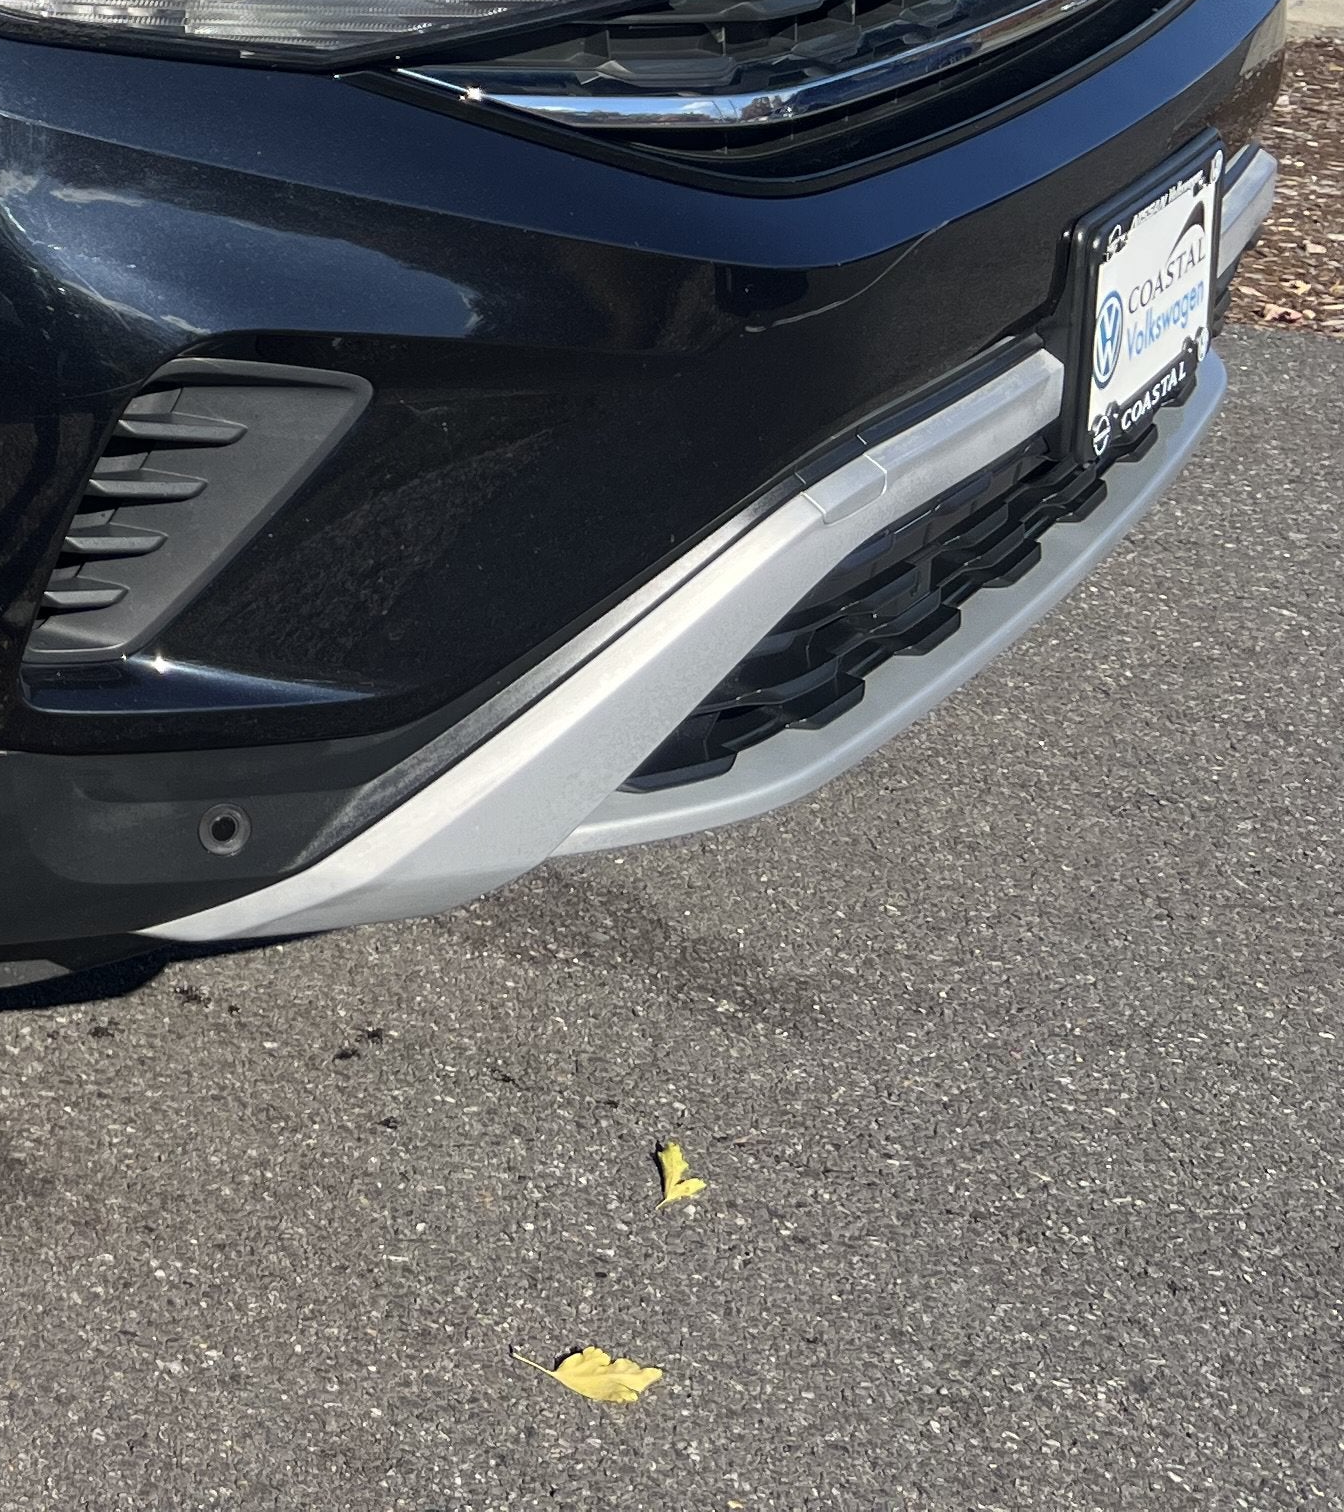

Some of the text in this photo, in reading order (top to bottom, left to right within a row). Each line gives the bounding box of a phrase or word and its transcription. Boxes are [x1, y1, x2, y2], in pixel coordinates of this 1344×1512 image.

[1127, 235, 1207, 315] COASTAL
[1125, 279, 1205, 361] Volkswagen
[1120, 360, 1187, 433] COASTAL
